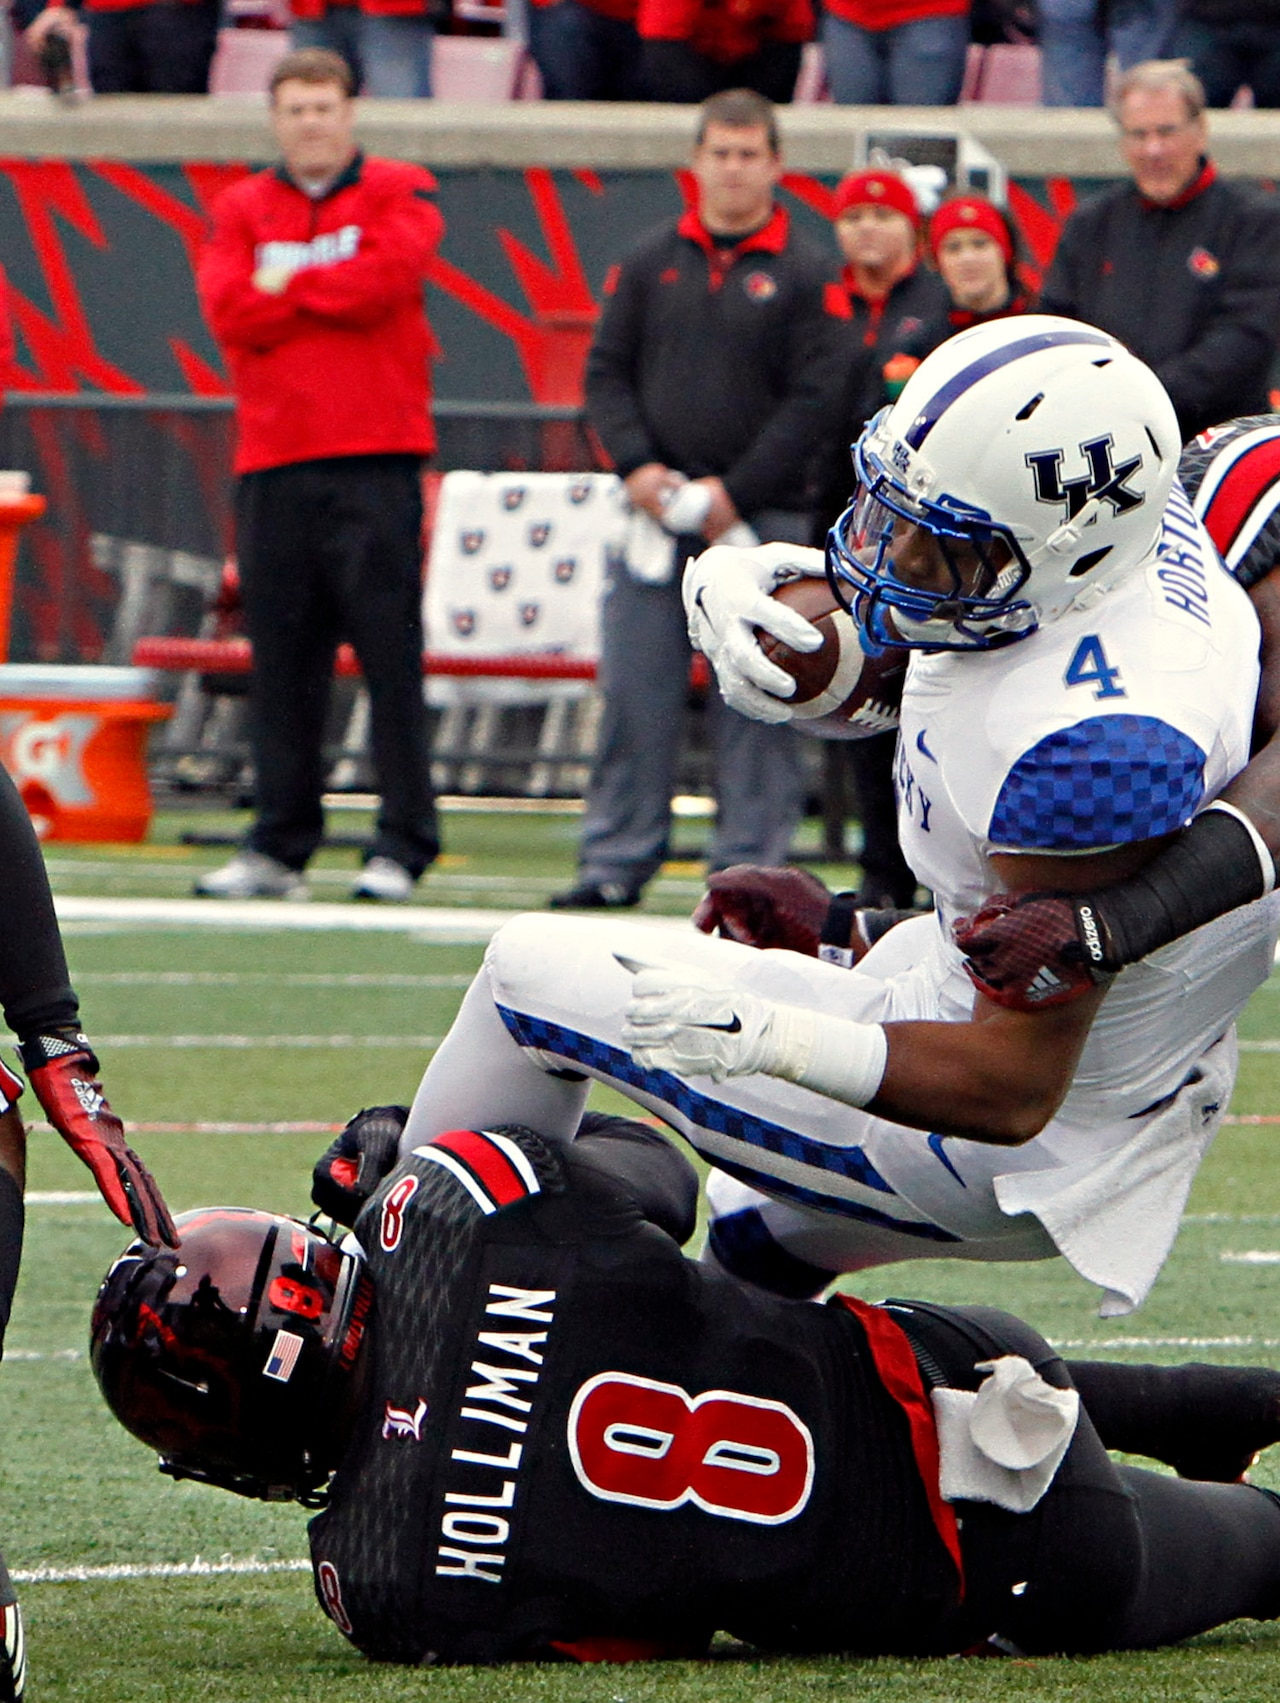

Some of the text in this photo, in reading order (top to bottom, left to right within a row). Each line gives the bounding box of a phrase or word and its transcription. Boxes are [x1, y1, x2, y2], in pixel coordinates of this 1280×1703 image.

[1157, 481, 1212, 628] HORTO
[1062, 633, 1129, 702] 4
[1080, 907, 1103, 961] adizero
[380, 1174, 419, 1252] 8
[268, 1276, 324, 1320] 8
[435, 1284, 557, 1583] HOLLIMAN
[567, 1371, 815, 1525] 8
